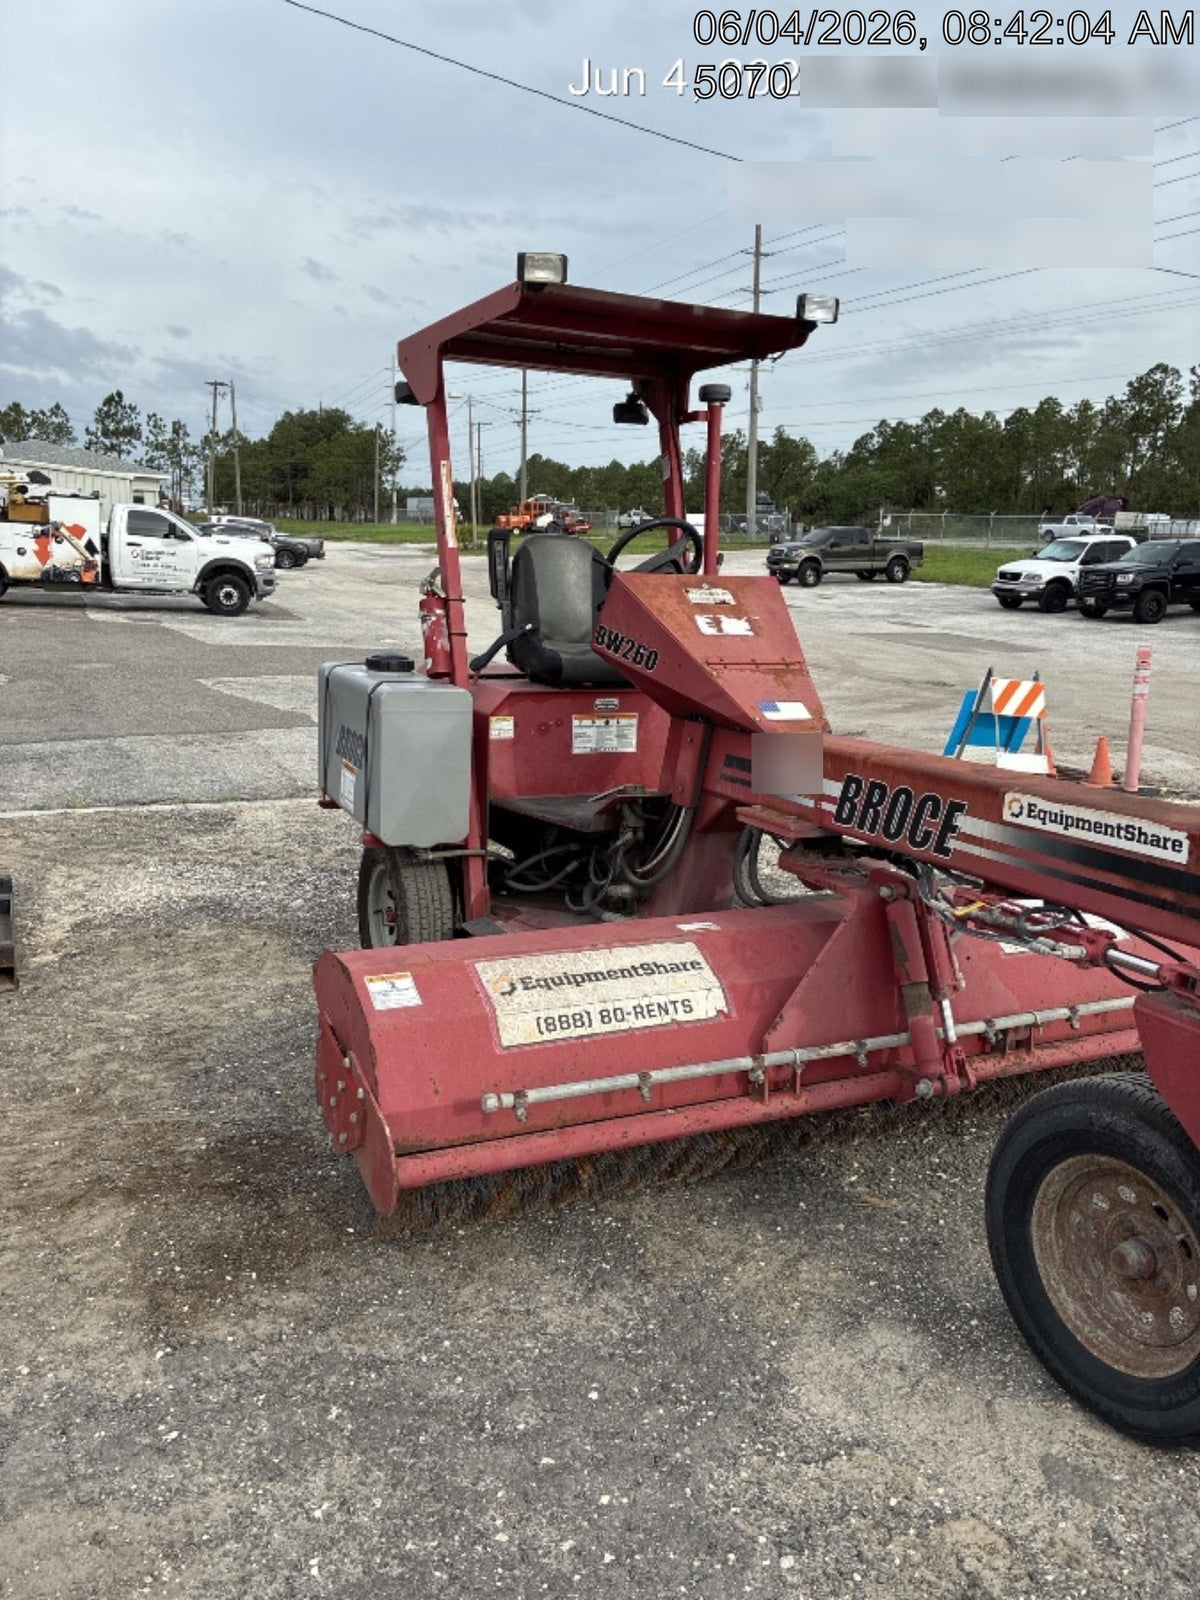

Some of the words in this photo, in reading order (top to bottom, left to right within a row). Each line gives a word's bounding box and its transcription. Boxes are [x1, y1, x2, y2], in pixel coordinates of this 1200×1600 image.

[594, 624, 660, 673] BW260
[833, 773, 968, 858] BROCE
[1025, 801, 1184, 854] EquipmentShare
[521, 958, 704, 992] EquipmentShare
[536, 1009, 593, 1036] (888)
[599, 998, 694, 1026] 80-RENTS
